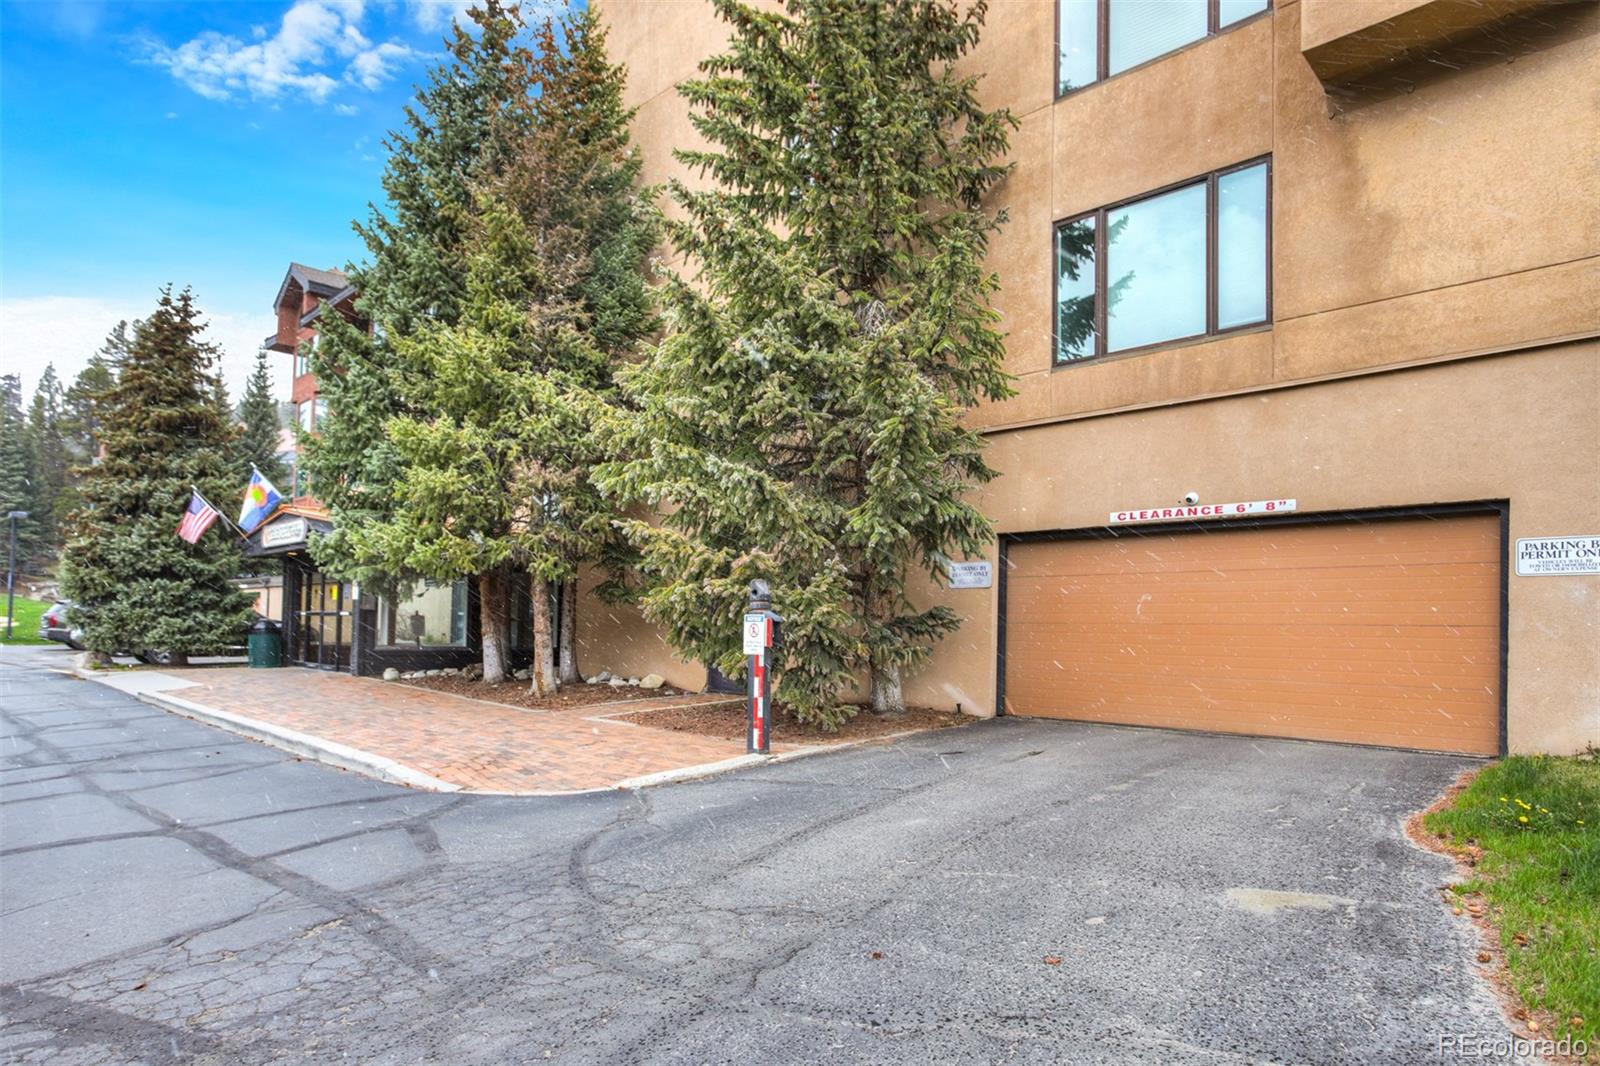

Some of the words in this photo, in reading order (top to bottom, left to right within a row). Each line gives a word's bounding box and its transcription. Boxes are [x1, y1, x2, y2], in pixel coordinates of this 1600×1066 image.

[1117, 505, 1224, 521] CLEARANCE
[1236, 504, 1253, 513] 6'
[1525, 540, 1586, 551] PARKING
[1591, 540, 1600, 548] B
[1521, 550, 1572, 559] PERMIT
[1576, 549, 1600, 558] ON
